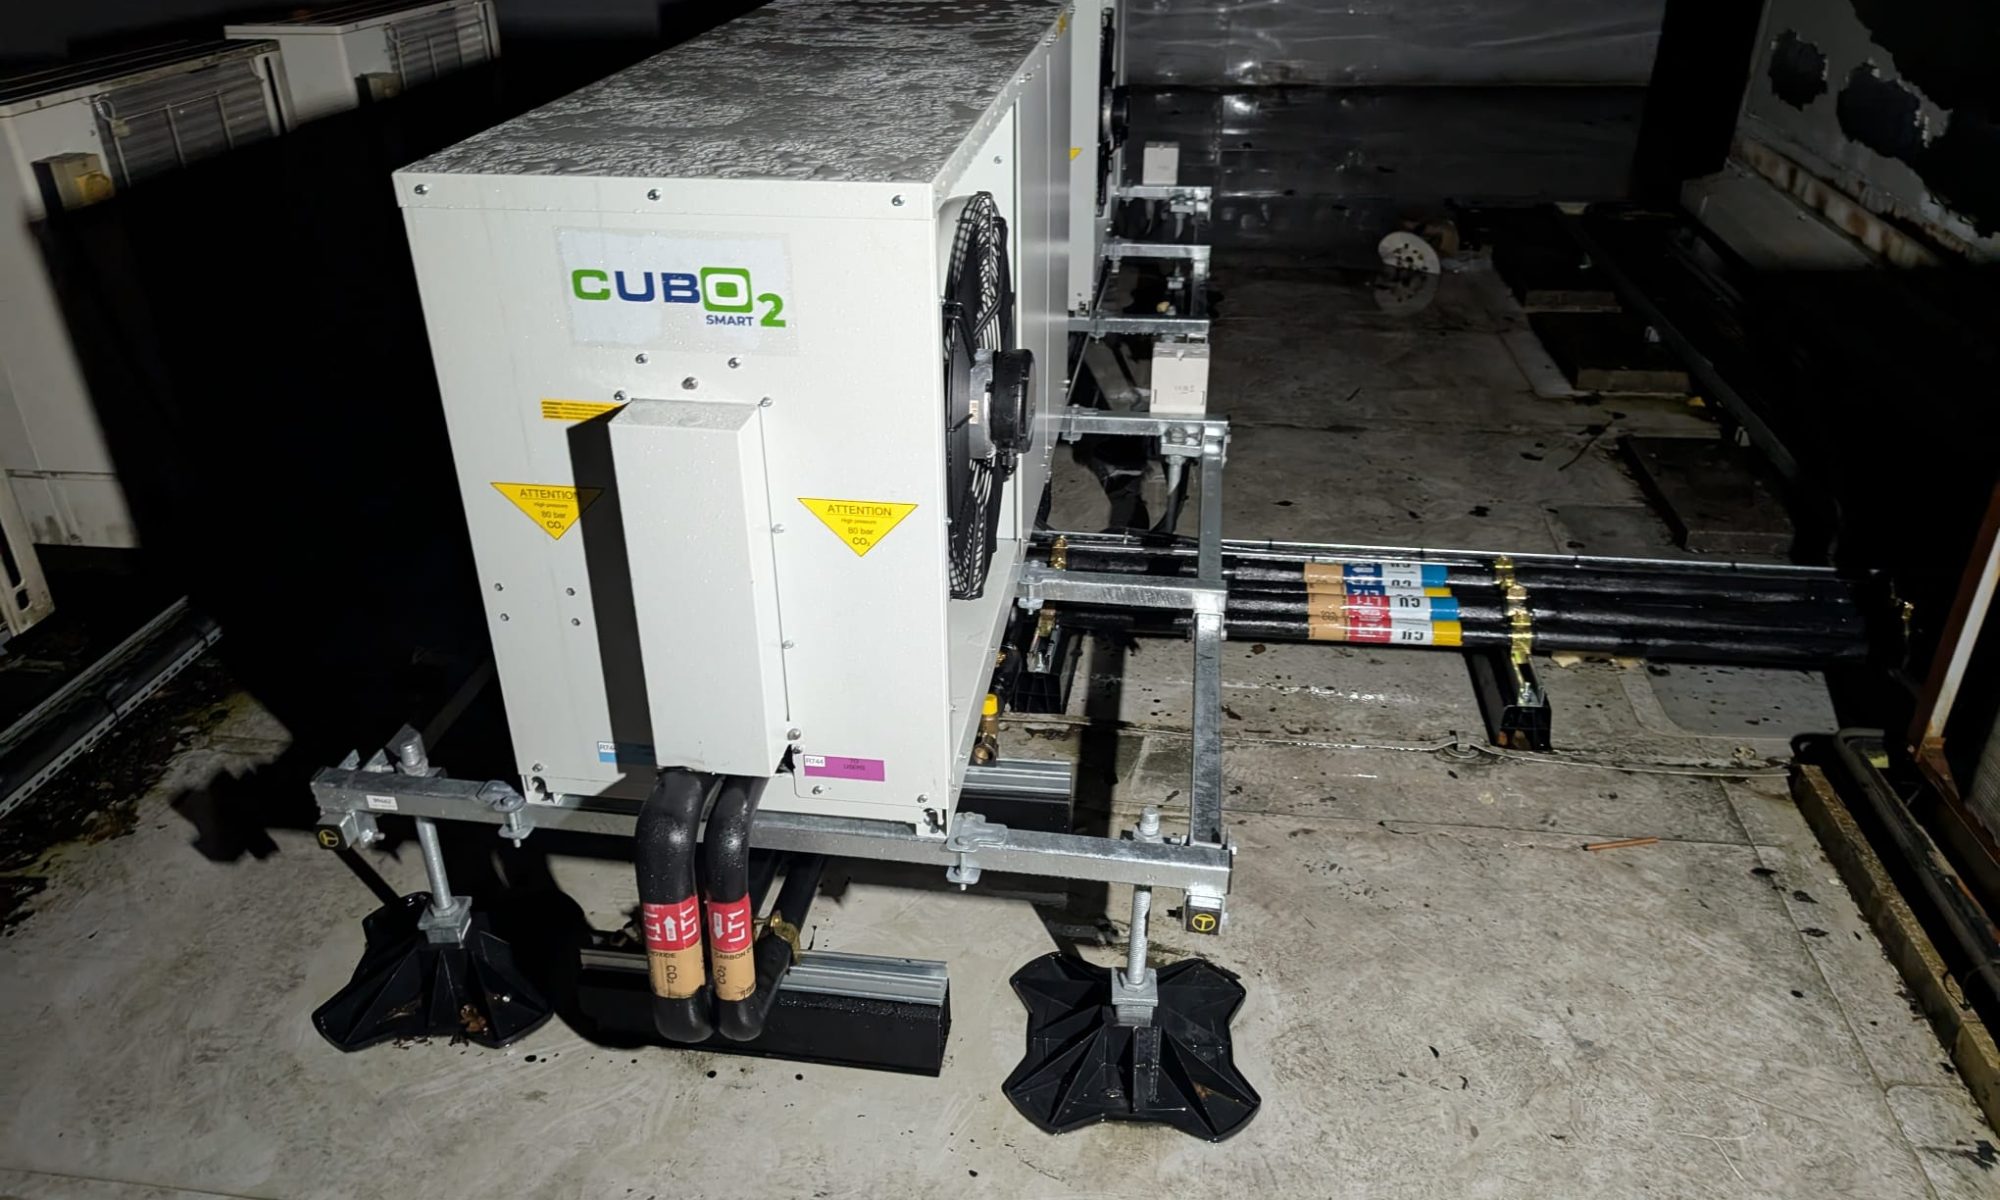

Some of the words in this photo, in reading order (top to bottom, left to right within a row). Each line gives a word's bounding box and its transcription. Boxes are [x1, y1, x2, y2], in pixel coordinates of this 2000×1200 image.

[705, 314, 754, 327] SMART
[520, 488, 578, 500] ATTENTIO
[827, 504, 892, 516] ATTENTION
[860, 526, 874, 535] bar
[680, 905, 698, 941] LT1
[727, 908, 746, 943] LT1
